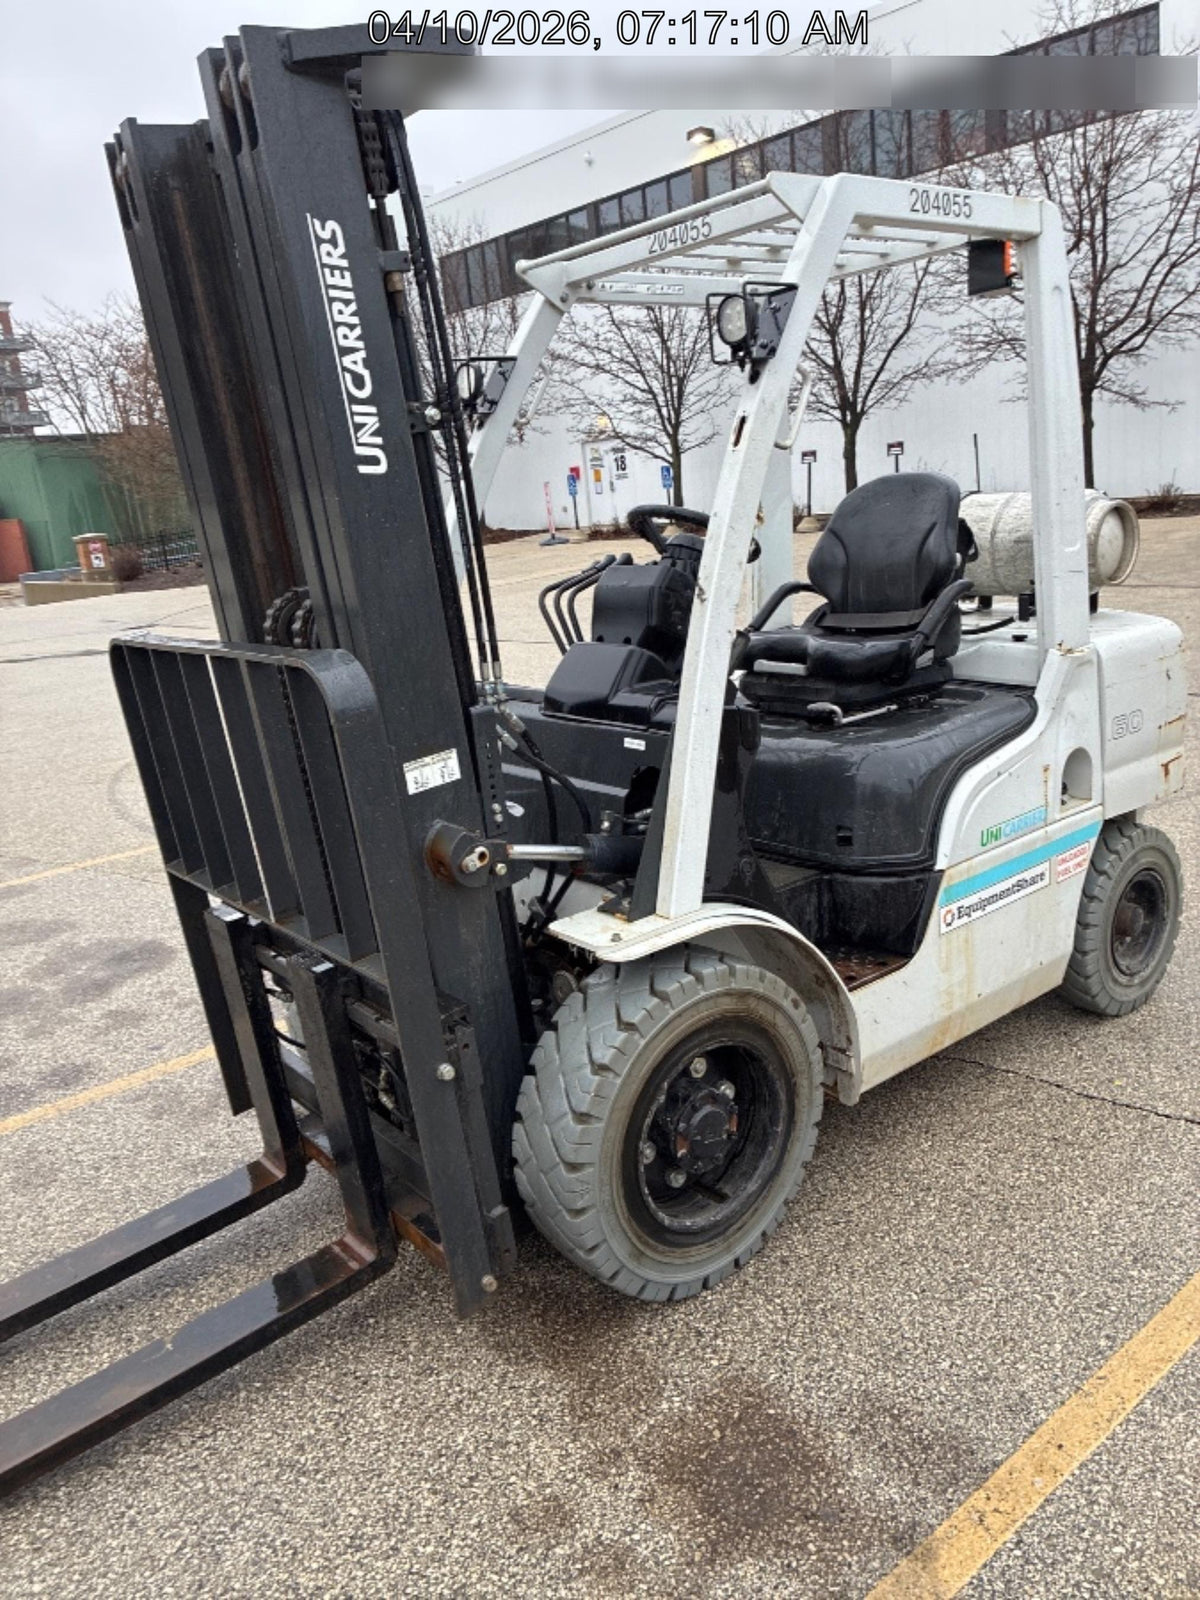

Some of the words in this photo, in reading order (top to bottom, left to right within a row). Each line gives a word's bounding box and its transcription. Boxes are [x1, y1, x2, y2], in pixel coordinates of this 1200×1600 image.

[909, 187, 972, 219] 204055
[648, 215, 712, 255] 204055
[614, 454, 627, 472] 18
[956, 872, 1046, 920] EquipmentShare
